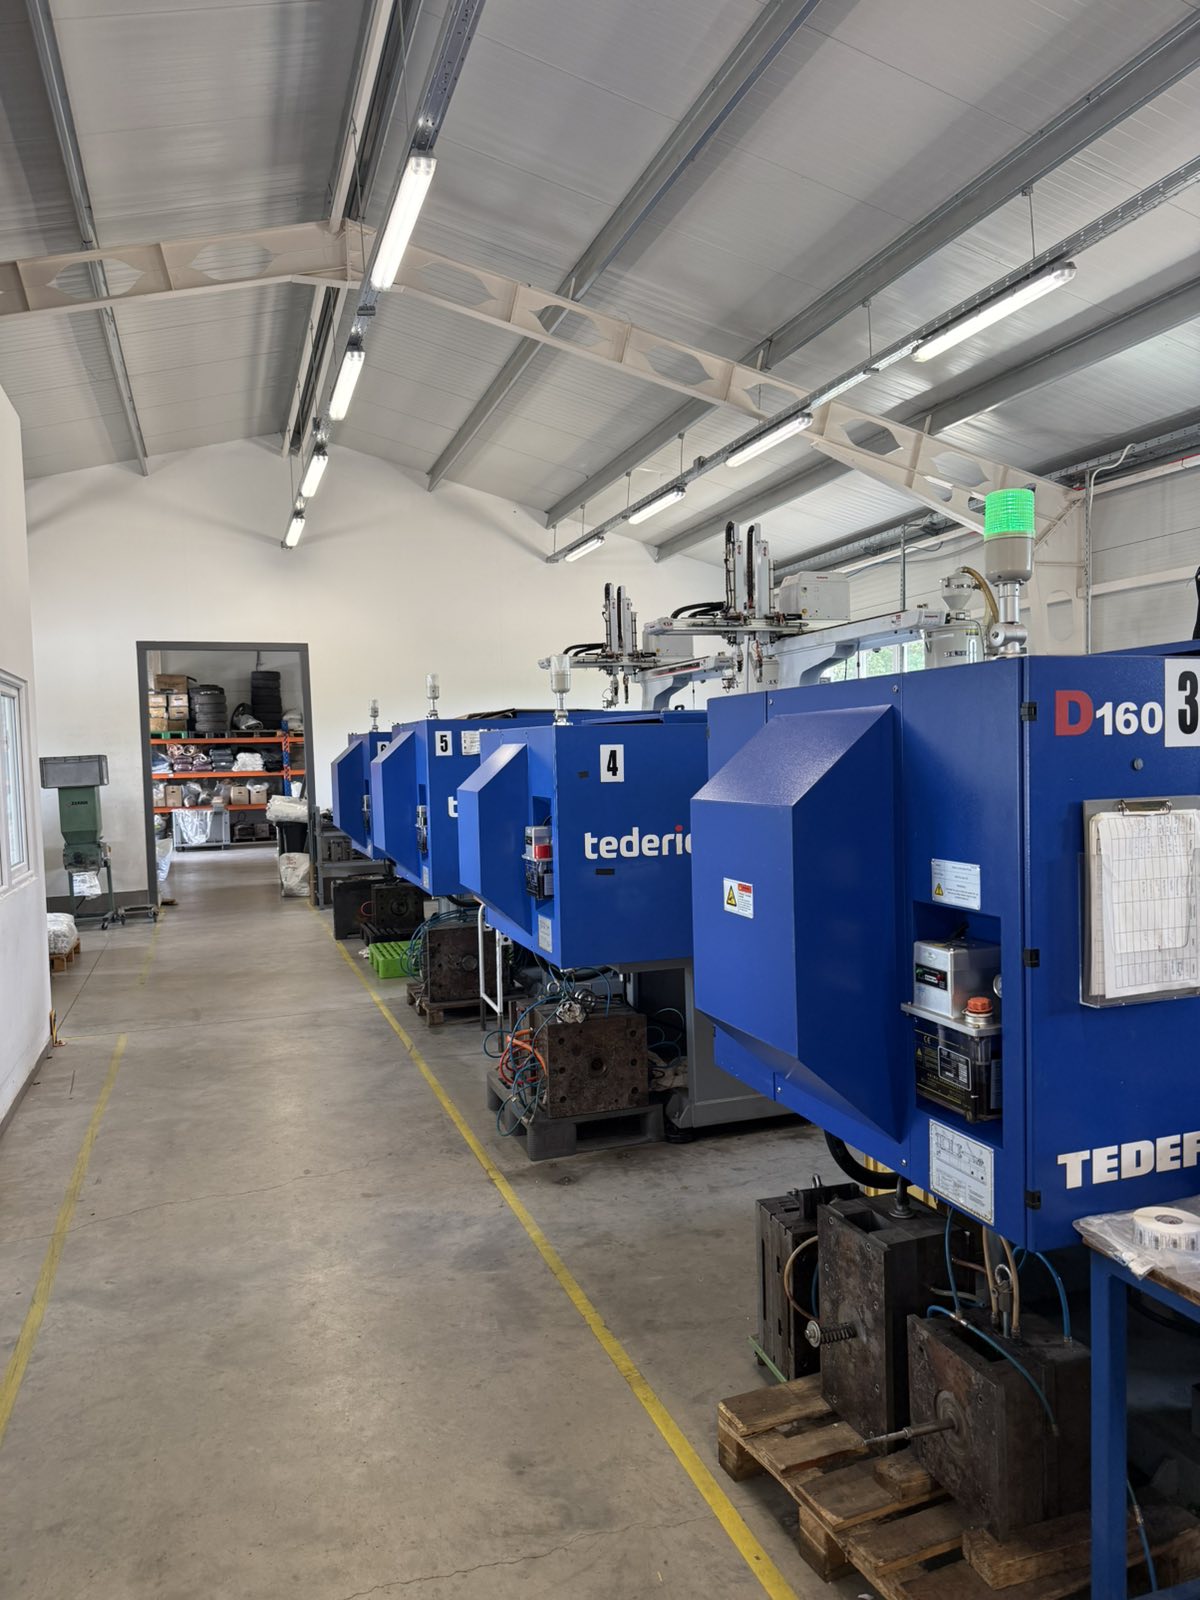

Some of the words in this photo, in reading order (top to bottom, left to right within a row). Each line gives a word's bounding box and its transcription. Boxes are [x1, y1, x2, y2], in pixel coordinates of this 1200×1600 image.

[1178, 670, 1199, 735] 3
[439, 734, 448, 752] 5
[607, 749, 618, 777] 4
